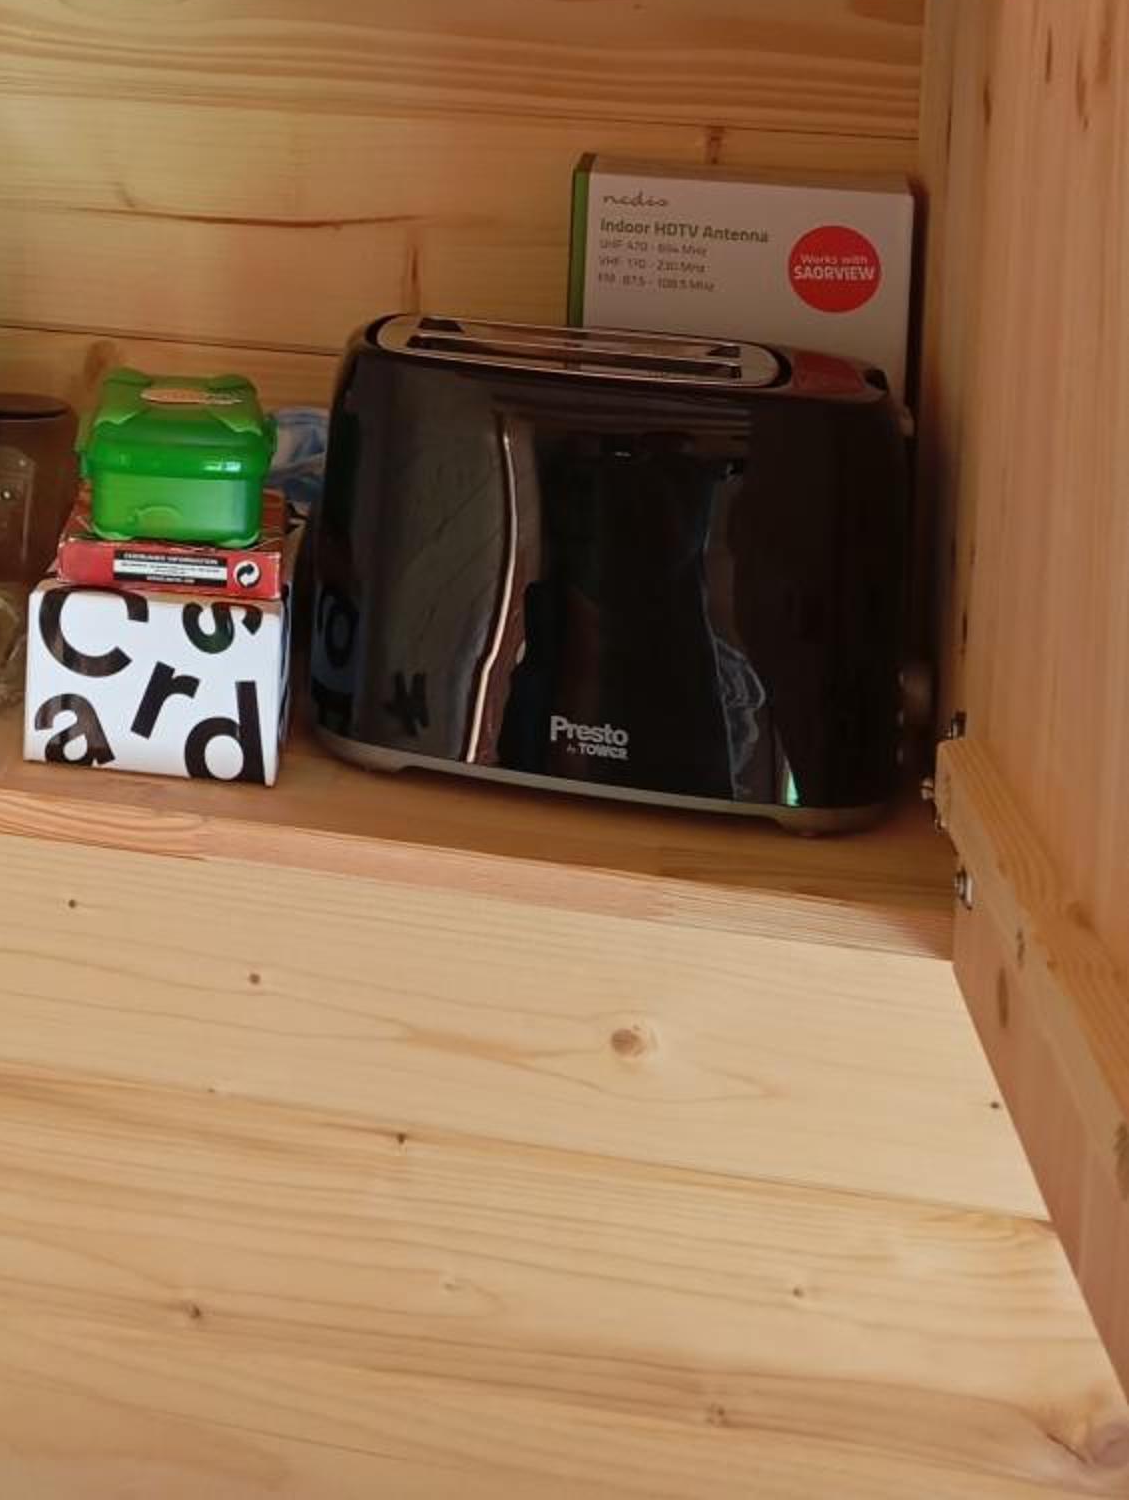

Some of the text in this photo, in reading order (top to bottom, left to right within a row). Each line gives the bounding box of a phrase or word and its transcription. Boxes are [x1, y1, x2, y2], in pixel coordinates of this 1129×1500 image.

[600, 218, 769, 243] Indoor HDTV Antenna
[799, 252, 869, 265] Works with
[793, 265, 875, 281] SAORVIEW
[549, 714, 630, 747] Presto
[578, 741, 630, 760] TOWER
